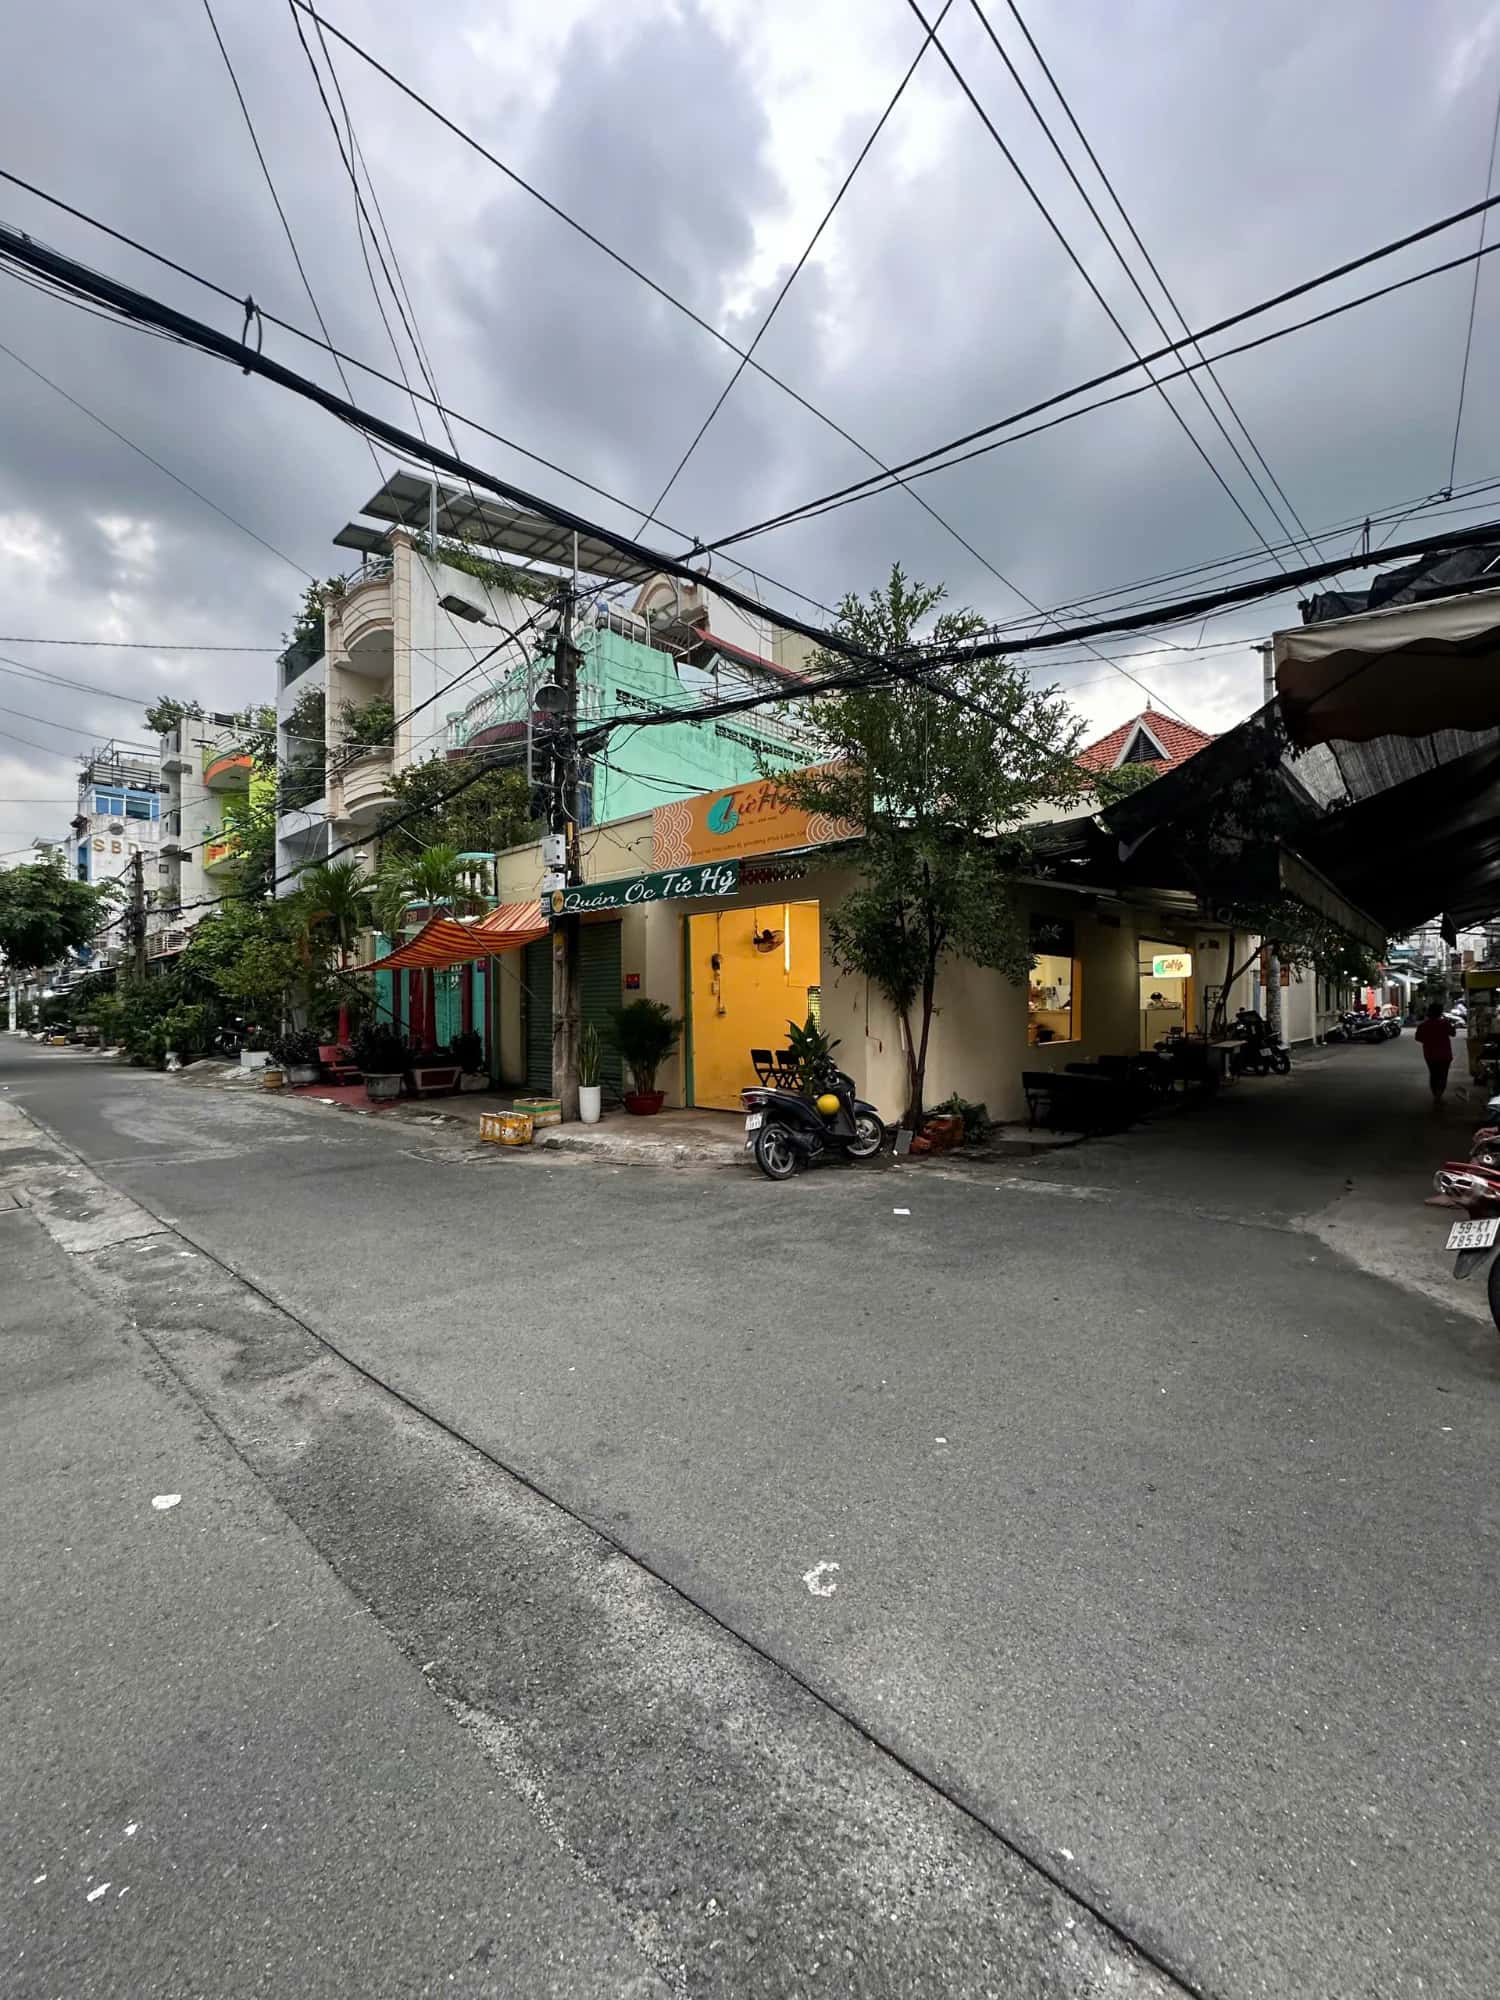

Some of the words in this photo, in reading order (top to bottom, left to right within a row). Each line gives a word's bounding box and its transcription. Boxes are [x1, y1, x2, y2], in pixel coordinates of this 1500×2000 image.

[564, 892, 617, 910] Quán
[625, 876, 655, 902] Ốc
[662, 872, 693, 897] Tứ
[699, 866, 736, 894] Hỷ
